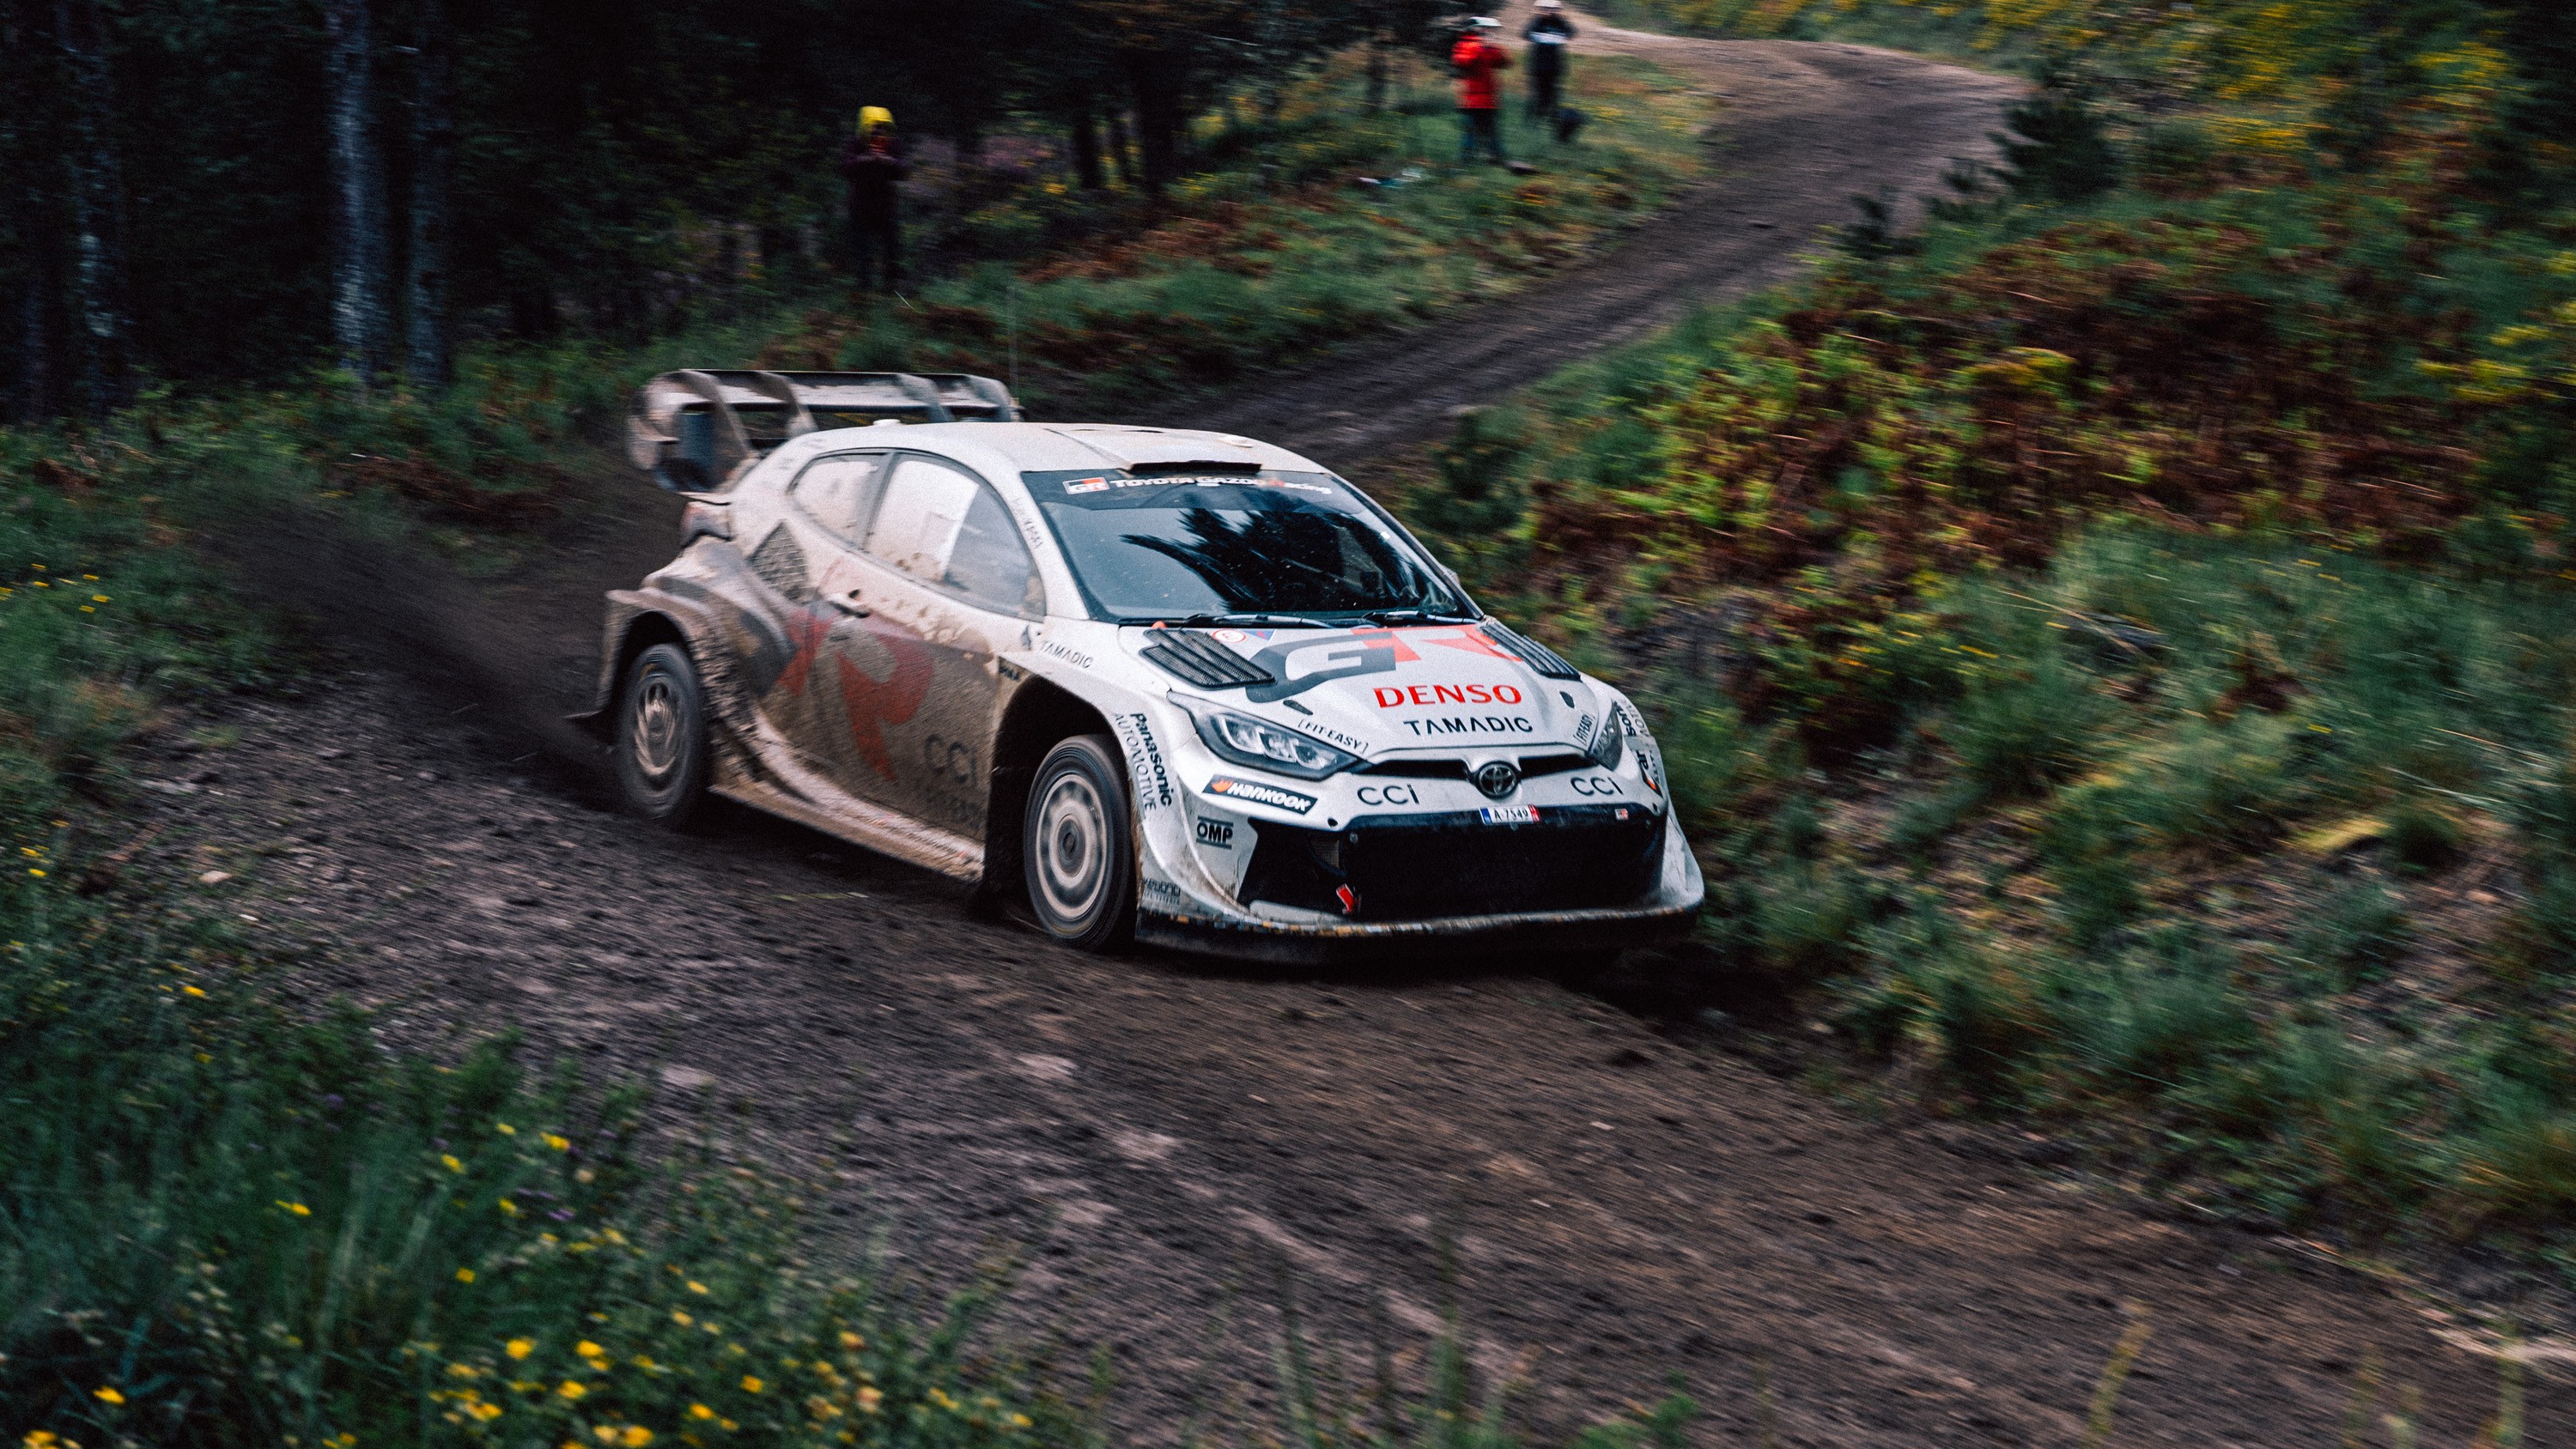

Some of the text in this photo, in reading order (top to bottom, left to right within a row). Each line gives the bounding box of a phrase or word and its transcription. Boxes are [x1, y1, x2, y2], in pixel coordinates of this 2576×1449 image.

[1109, 477, 1194, 488] TOYOTA
[1040, 640, 1093, 669] TAMADIC
[1374, 684, 1522, 708] DENSO
[1403, 716, 1533, 737] TAMADIC
[1115, 713, 1157, 810] AUTOMOTIVE
[1130, 712, 1175, 808] Panasonic
[1357, 783, 1419, 806] CCI
[1570, 776, 1625, 797] CCI
[1196, 822, 1233, 844] OMP
